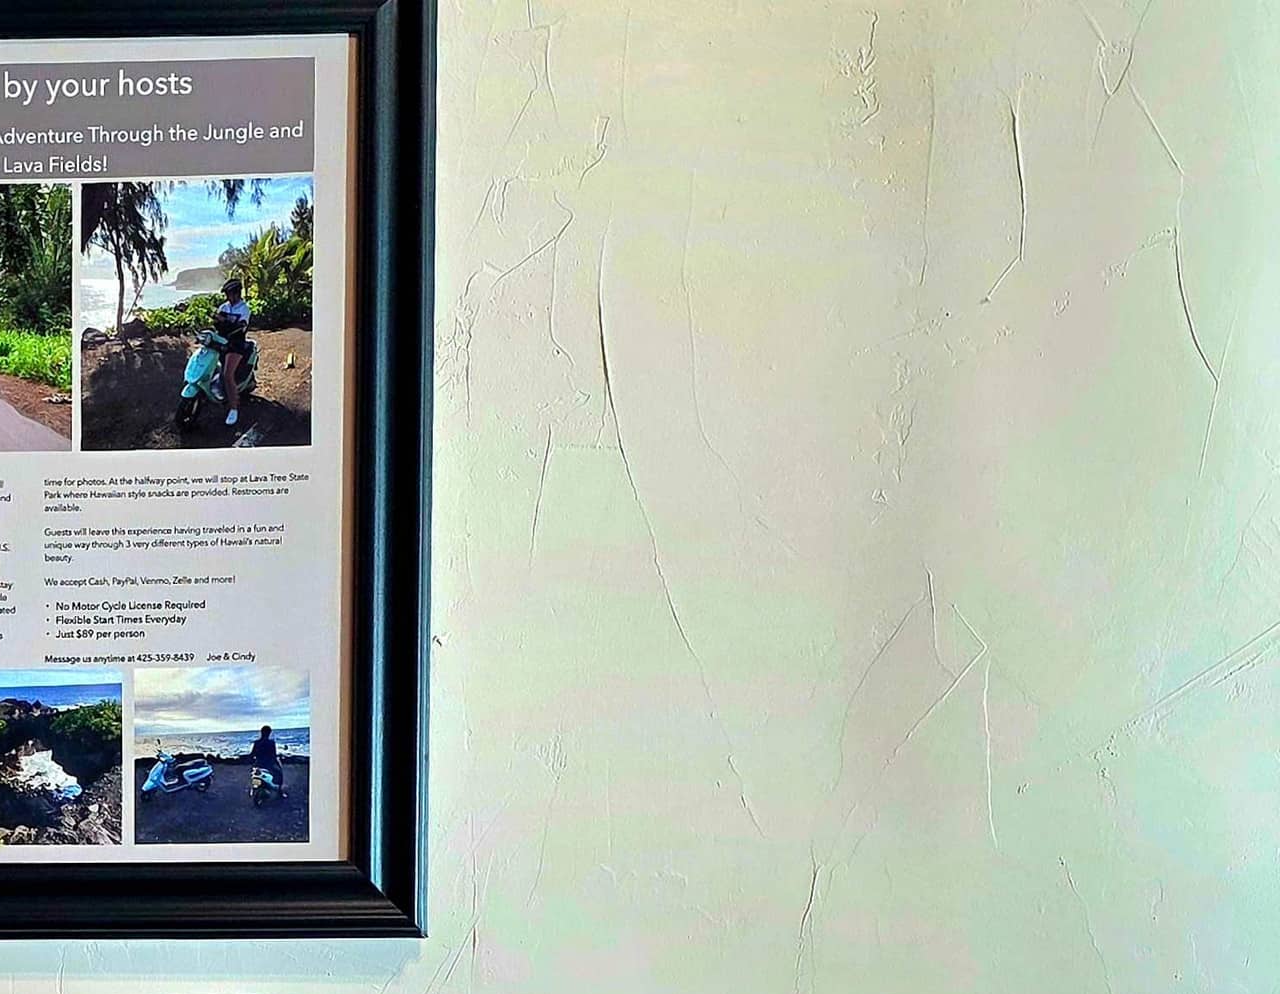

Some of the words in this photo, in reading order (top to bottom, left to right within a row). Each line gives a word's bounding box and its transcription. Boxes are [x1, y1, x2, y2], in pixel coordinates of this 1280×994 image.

[4, 70, 38, 105] by
[45, 78, 110, 105] your
[118, 68, 193, 97] hosts
[87, 123, 164, 148] Through
[168, 123, 198, 142] the
[202, 121, 264, 145] Jungle
[269, 119, 304, 139] and
[3, 155, 43, 174] Lava
[48, 153, 107, 173] Fields!
[43, 577, 58, 586] We
[59, 578, 87, 588] accept
[88, 576, 110, 587] Cash,
[112, 576, 139, 588] PayPal,
[139, 576, 171, 585] Venmo,
[172, 575, 192, 585] Zelle
[194, 575, 210, 584] and
[211, 575, 236, 584] more!
[55, 601, 70, 611] No
[71, 601, 100, 611] Motor
[101, 600, 127, 613] Cycle
[128, 600, 162, 610] License
[164, 599, 206, 612] Required
[55, 614, 91, 625] Flexible
[93, 615, 114, 624] Start
[116, 614, 143, 624] Times
[145, 613, 187, 626] Everyday
[55, 629, 74, 639] Just
[76, 629, 94, 639] $89
[96, 631, 112, 640] per
[113, 630, 145, 640] person
[44, 654, 81, 665] Message
[93, 654, 126, 665] anytime
[206, 653, 222, 661] Joe
[223, 652, 230, 661] &
[231, 651, 256, 663] Cindy
